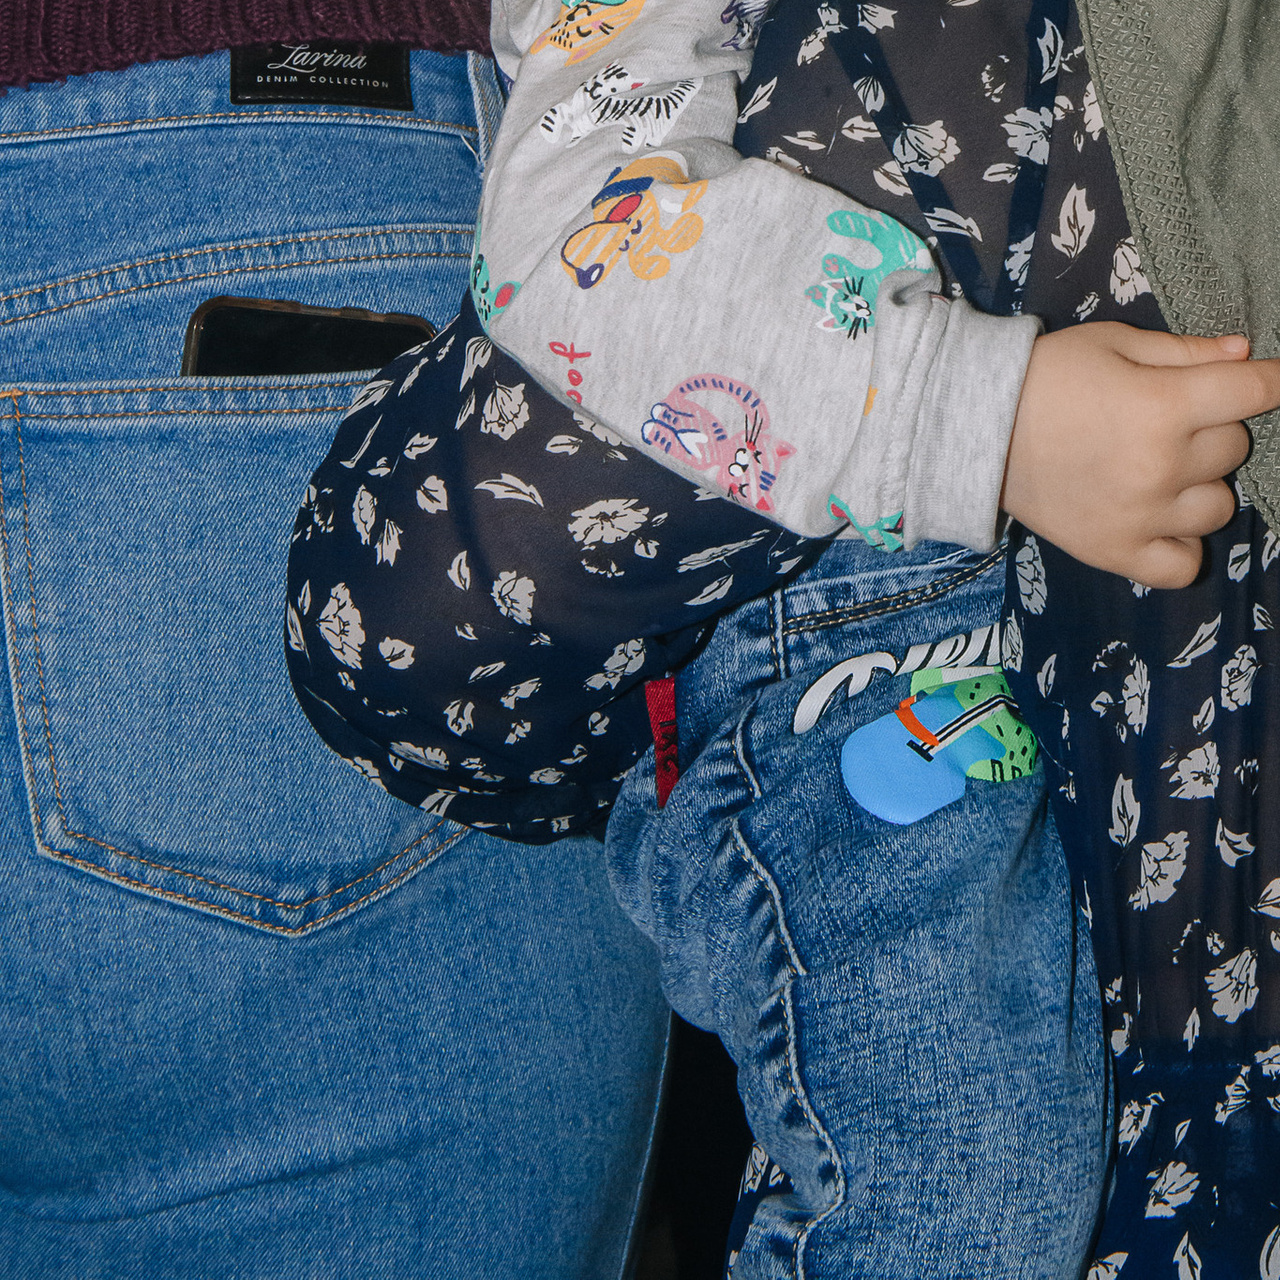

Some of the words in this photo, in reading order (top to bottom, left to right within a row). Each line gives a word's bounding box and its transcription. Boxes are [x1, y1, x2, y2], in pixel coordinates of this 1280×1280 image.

[267, 43, 367, 73] Larina
[256, 74, 298, 83] DENIM
[309, 75, 389, 88] COLLECTION
